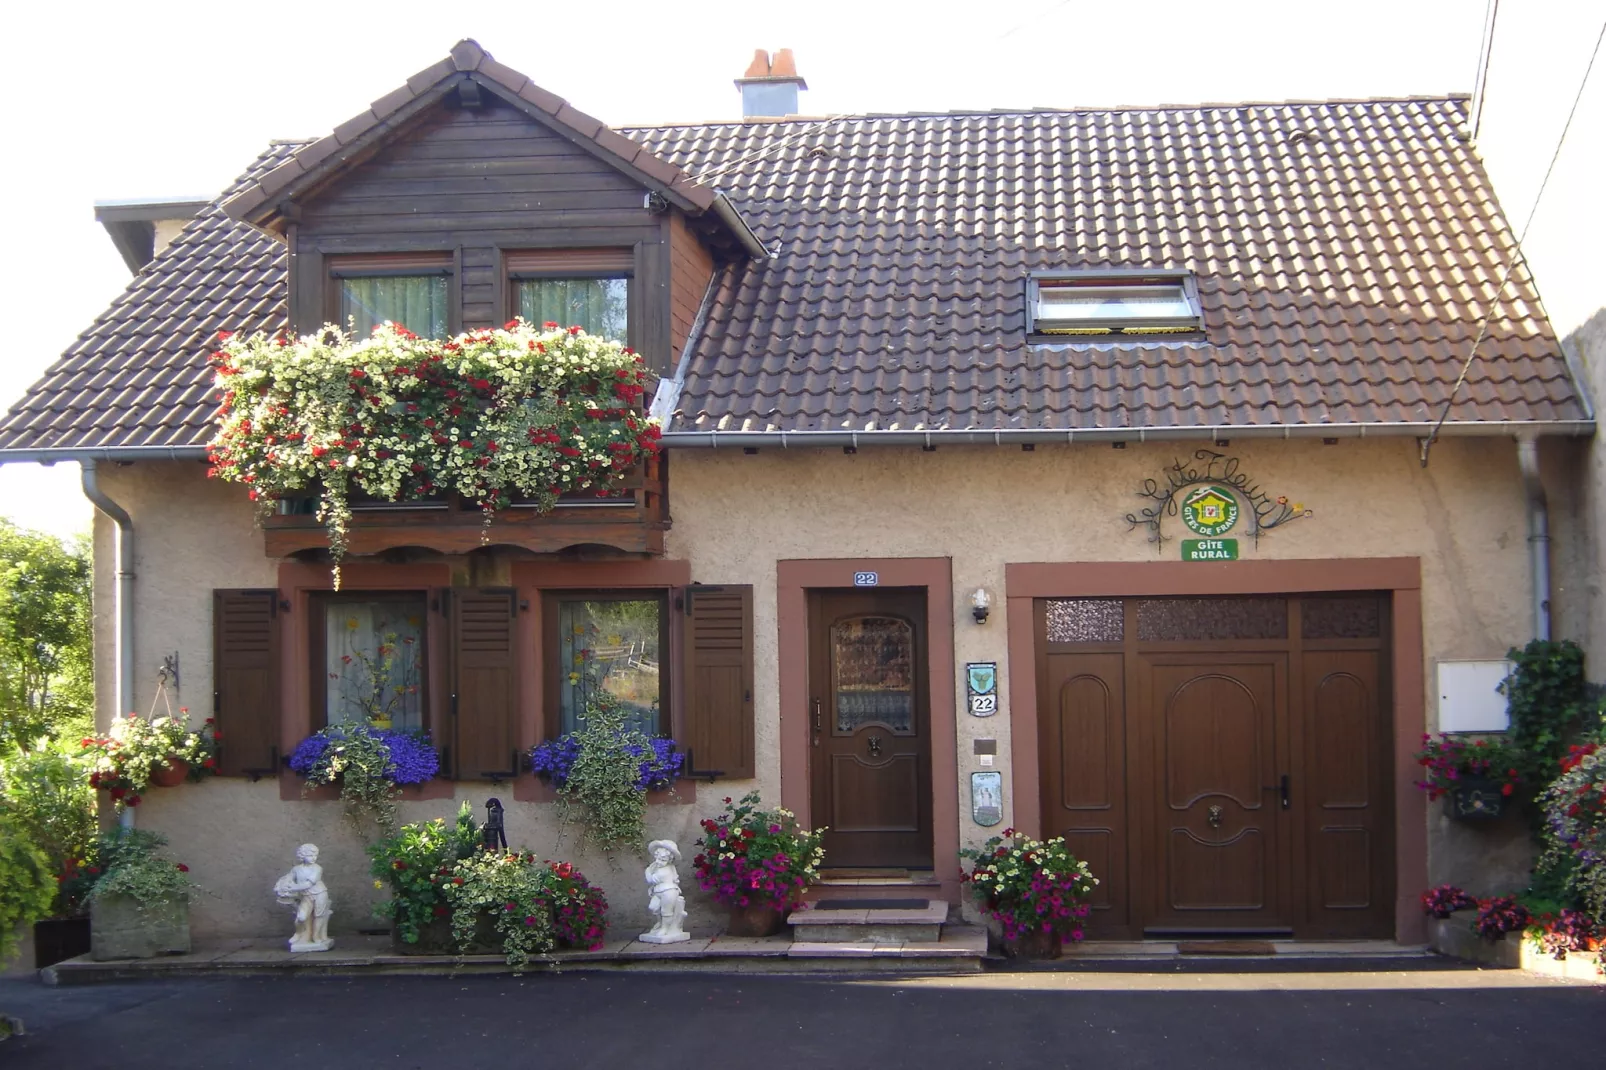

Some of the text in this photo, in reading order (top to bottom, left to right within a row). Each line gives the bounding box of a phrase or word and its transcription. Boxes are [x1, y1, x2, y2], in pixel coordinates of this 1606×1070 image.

[1199, 526, 1213, 535] DE
[1215, 505, 1237, 534] FRANCE
[1191, 550, 1230, 559] RURAL
[857, 574, 875, 584] 22
[974, 697, 992, 710] 22
